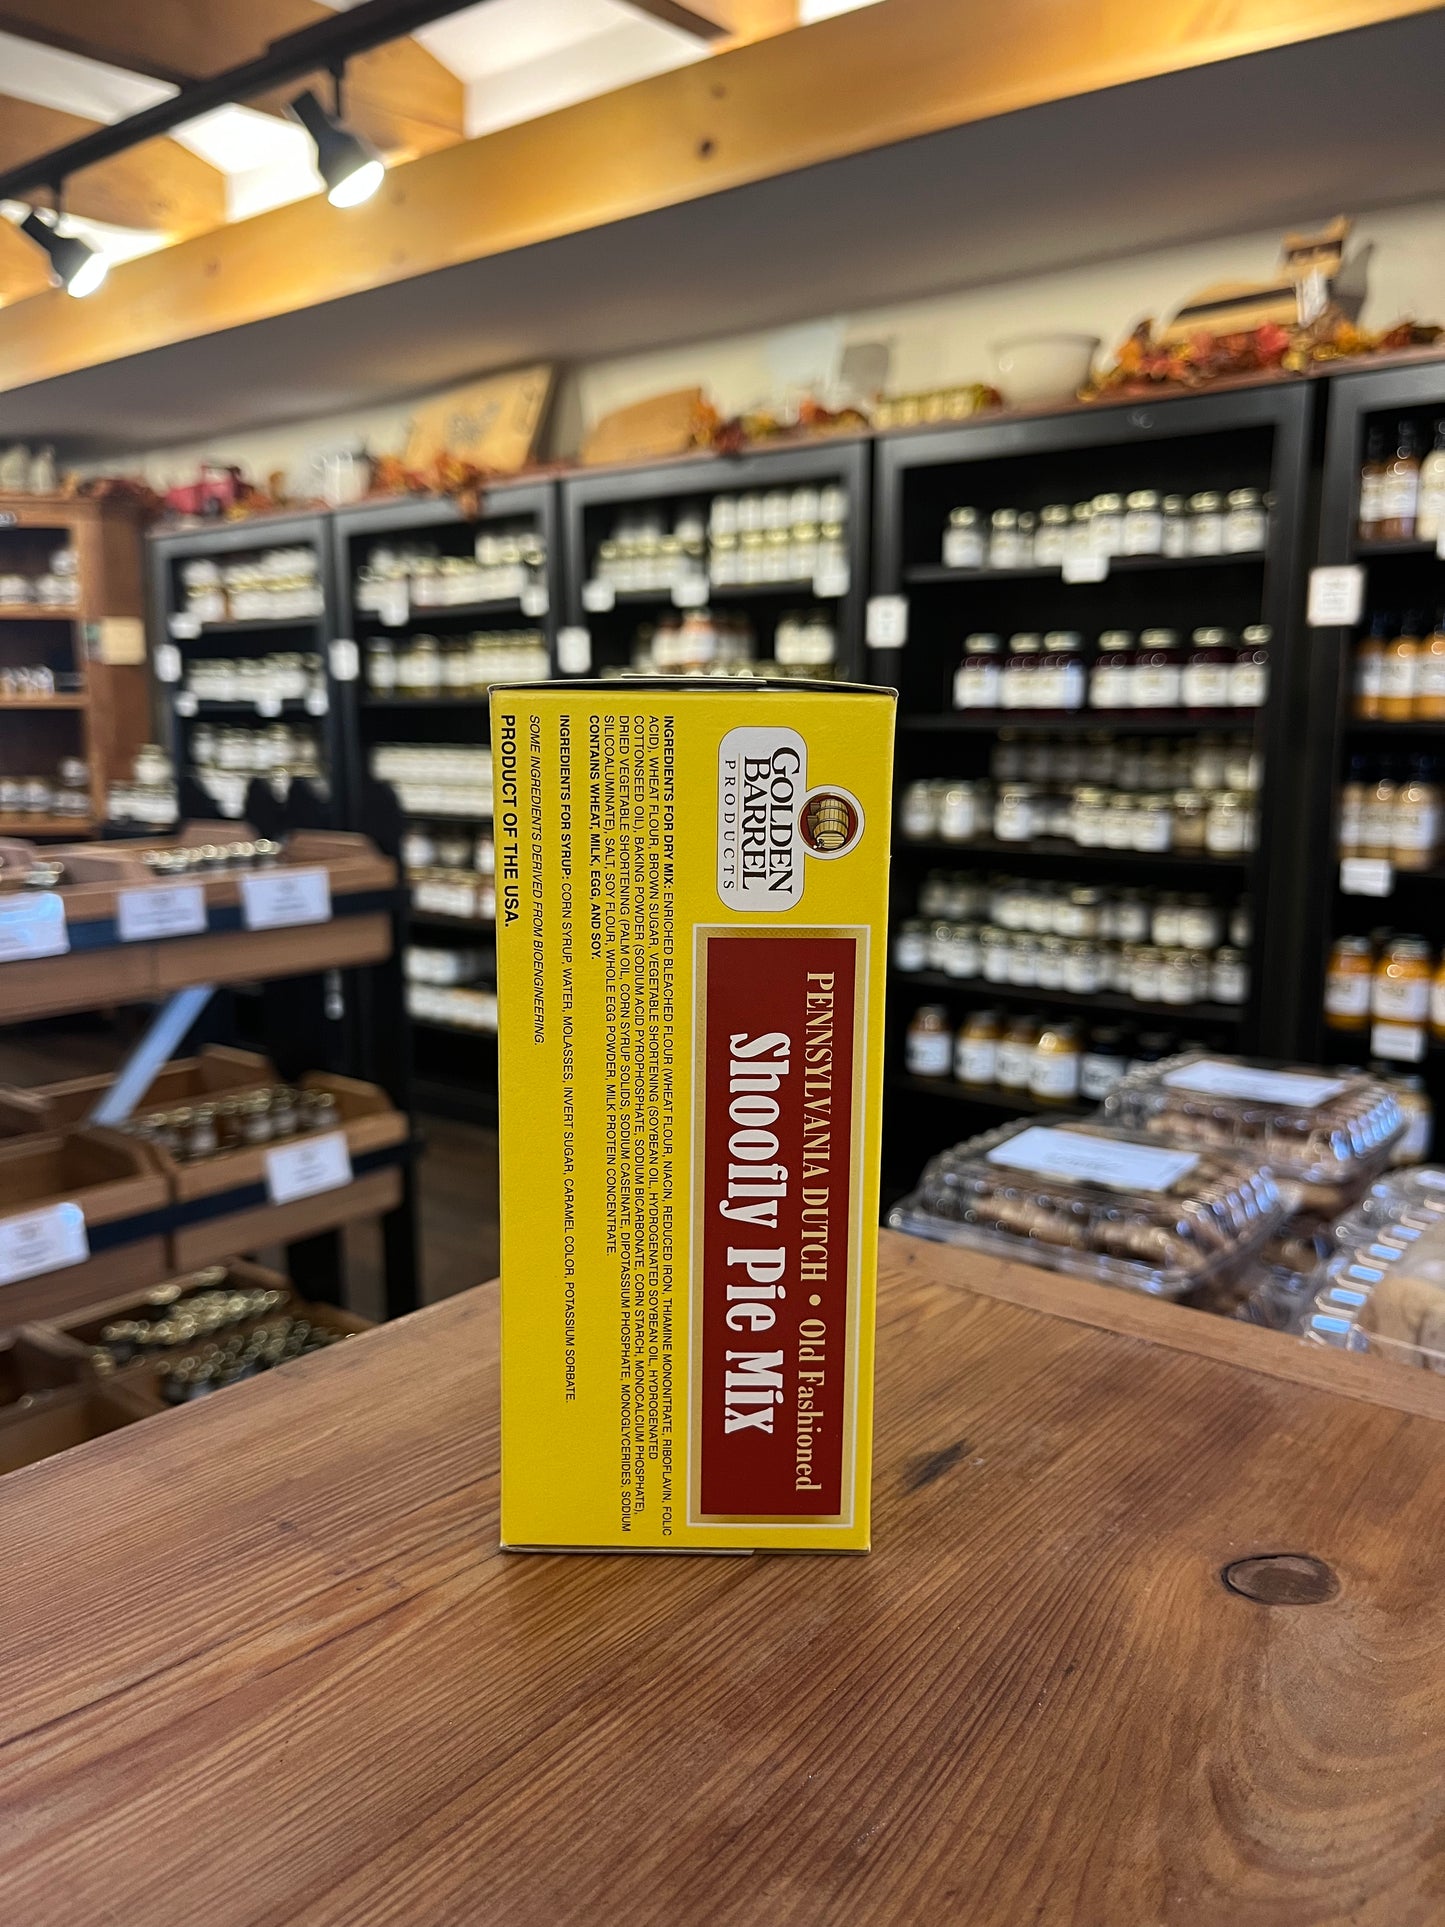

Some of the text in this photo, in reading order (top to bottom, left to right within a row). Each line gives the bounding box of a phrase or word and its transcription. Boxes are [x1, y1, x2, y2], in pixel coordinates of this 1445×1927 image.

[502, 715, 518, 926] PRODUCT OF THE USA.
[530, 714, 544, 1047] SOME INGREDIENTS DERIVED FROM BIOENGINEERING.
[590, 715, 601, 959] CONTAINS WHEAT, MILK, EGG, AND SOY.
[604, 715, 616, 1256] SILICOALUMINATE), SALT, SOY FLOUR, WHOLE EGG POWDER, MILK PROTEIN CONCENTRATE.
[724, 760, 736, 889] PRODUCTS
[742, 756, 771, 890] BARREL
[769, 747, 800, 894] GOLDEN
[560, 715, 575, 1403] INGREDIENTS FOR SYRUP: CORN SYRUP, WATER, MOLASSES, INVERT SUGAR, CARAMEL COLOR, POTASSIUM SORBATE.
[619, 716, 631, 1531] DRIED VEGETABLE SHORTENING (PALM OIL, CORN SYRUP SOLIDS, SODIUM CASEINATE, DIPOTASSIUM PHOSPHATE, MONOGLYCERIDES, SODIUM
[633, 716, 644, 1514] COTTONSEED OIL), BAKING POWDER (SODIUM ACID PYROPHOSPHATE, SODIUM BICARBONATE, CORN STARCH, MONOCALCIUM PHOSPHATE),
[647, 716, 659, 1459] ACID), WHEAT FLOUR, BROWN SUGAR, VEGETABLE SHORTENING (SOYBEAN OIL, HYDROGENATED SOYBEAN OIL, HYDROGENATED
[662, 716, 674, 1535] INGREDIENTS FOR DRY MIX: ENRICHED BLEACHED FLOUR (WHEAT FLOUR, NIACIN, REDUCED IRON, THIAMINE MONONITRATE, RIBOFLAVIN, FOLIC
[719, 1032, 790, 1434] Shoofly Pie Mix
[795, 972, 834, 1491] PENNSYLVANIA DUTCH Old Fashioned
